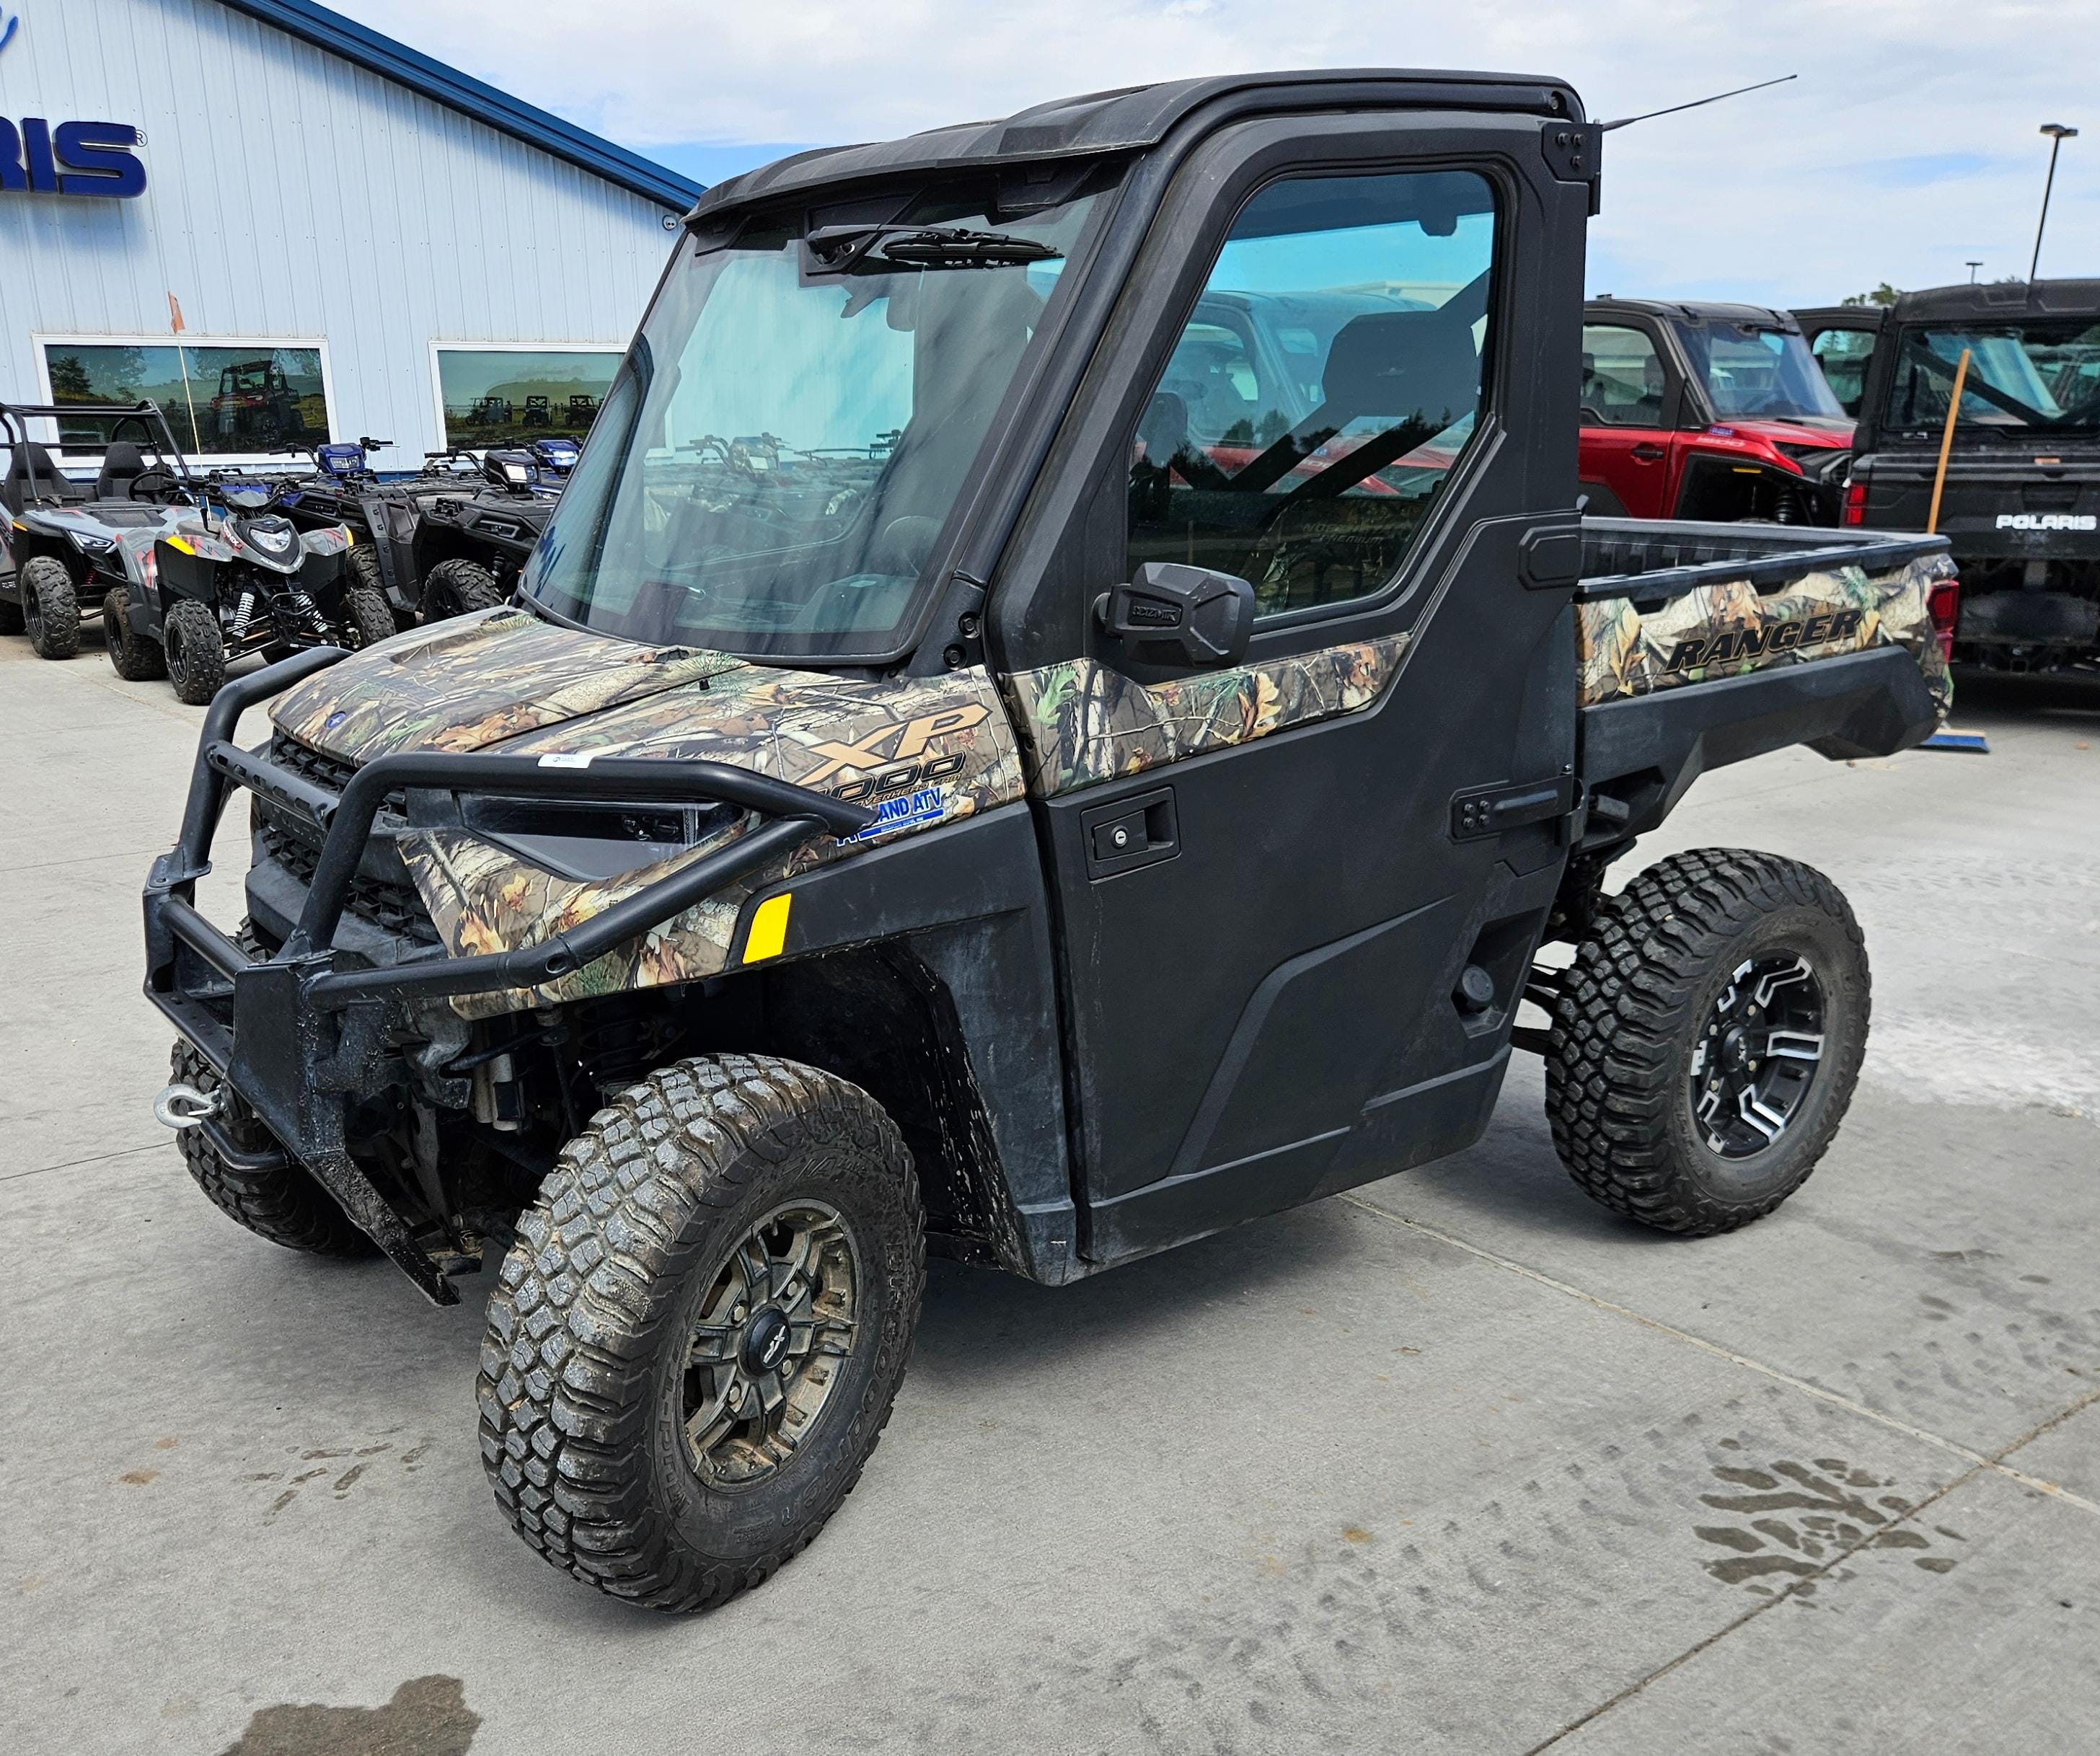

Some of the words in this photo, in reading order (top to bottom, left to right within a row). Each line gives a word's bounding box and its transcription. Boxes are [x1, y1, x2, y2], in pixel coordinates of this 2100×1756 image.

[1995, 514, 2097, 530] POLARIS
[1664, 609, 1863, 674] RANGER
[793, 700, 993, 787] XP
[870, 797, 909, 823] AND
[913, 787, 940, 813] ATV
